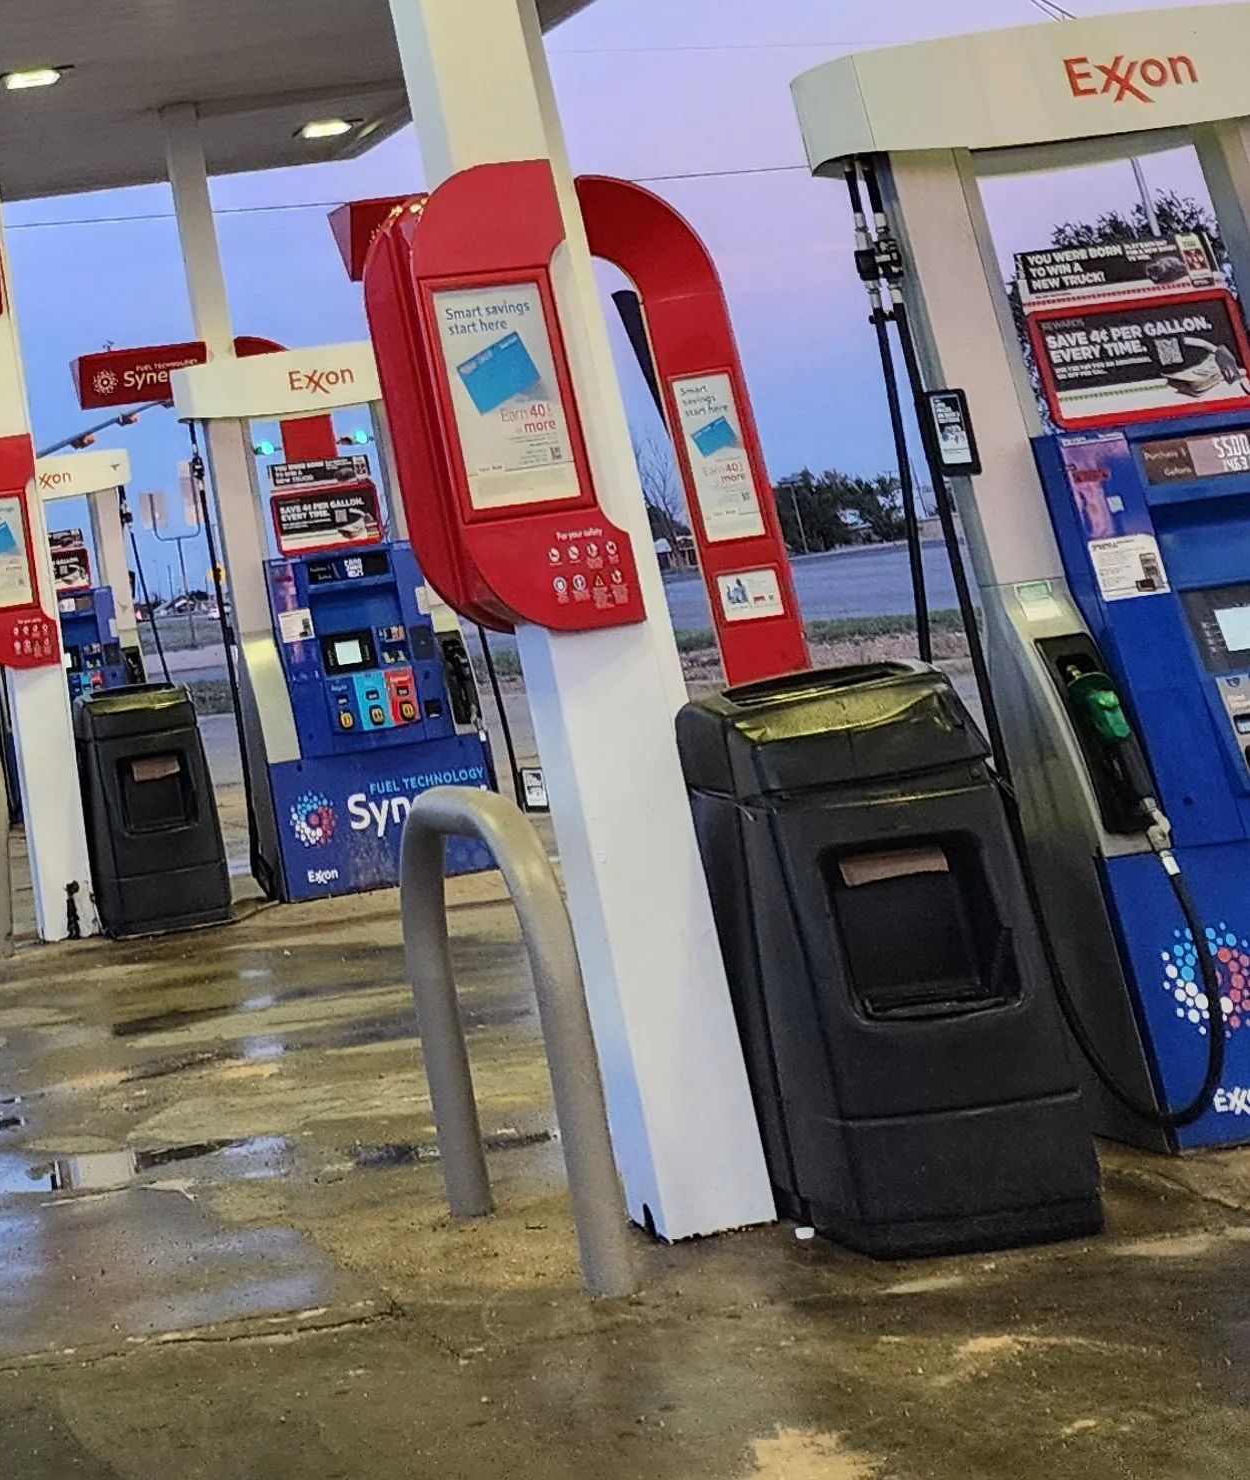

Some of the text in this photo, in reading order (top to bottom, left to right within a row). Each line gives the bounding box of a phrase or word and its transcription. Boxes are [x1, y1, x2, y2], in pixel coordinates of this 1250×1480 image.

[1062, 55, 1199, 103] Exxon
[1027, 244, 1123, 266] YOU WERE BORN
[1030, 267, 1046, 278] TO
[1046, 265, 1072, 276] WIN
[1072, 264, 1083, 273] A
[1031, 271, 1106, 291] NEW TRUCK!
[445, 300, 530, 321] Smart savings
[448, 319, 508, 335] start here
[1045, 316, 1212, 350] SAVE 4¢ PER GALLON.
[1050, 340, 1148, 364] EVERY TIME.
[123, 370, 168, 390] Syne
[288, 367, 355, 395] Exxon
[500, 406, 529, 422] Earn
[524, 420, 556, 434] more
[38, 472, 72, 489] xxon
[369, 766, 485, 795] FUEL TECHNOLOGY
[306, 868, 339, 885] Exxon
[1213, 1086, 1250, 1117] Exx
